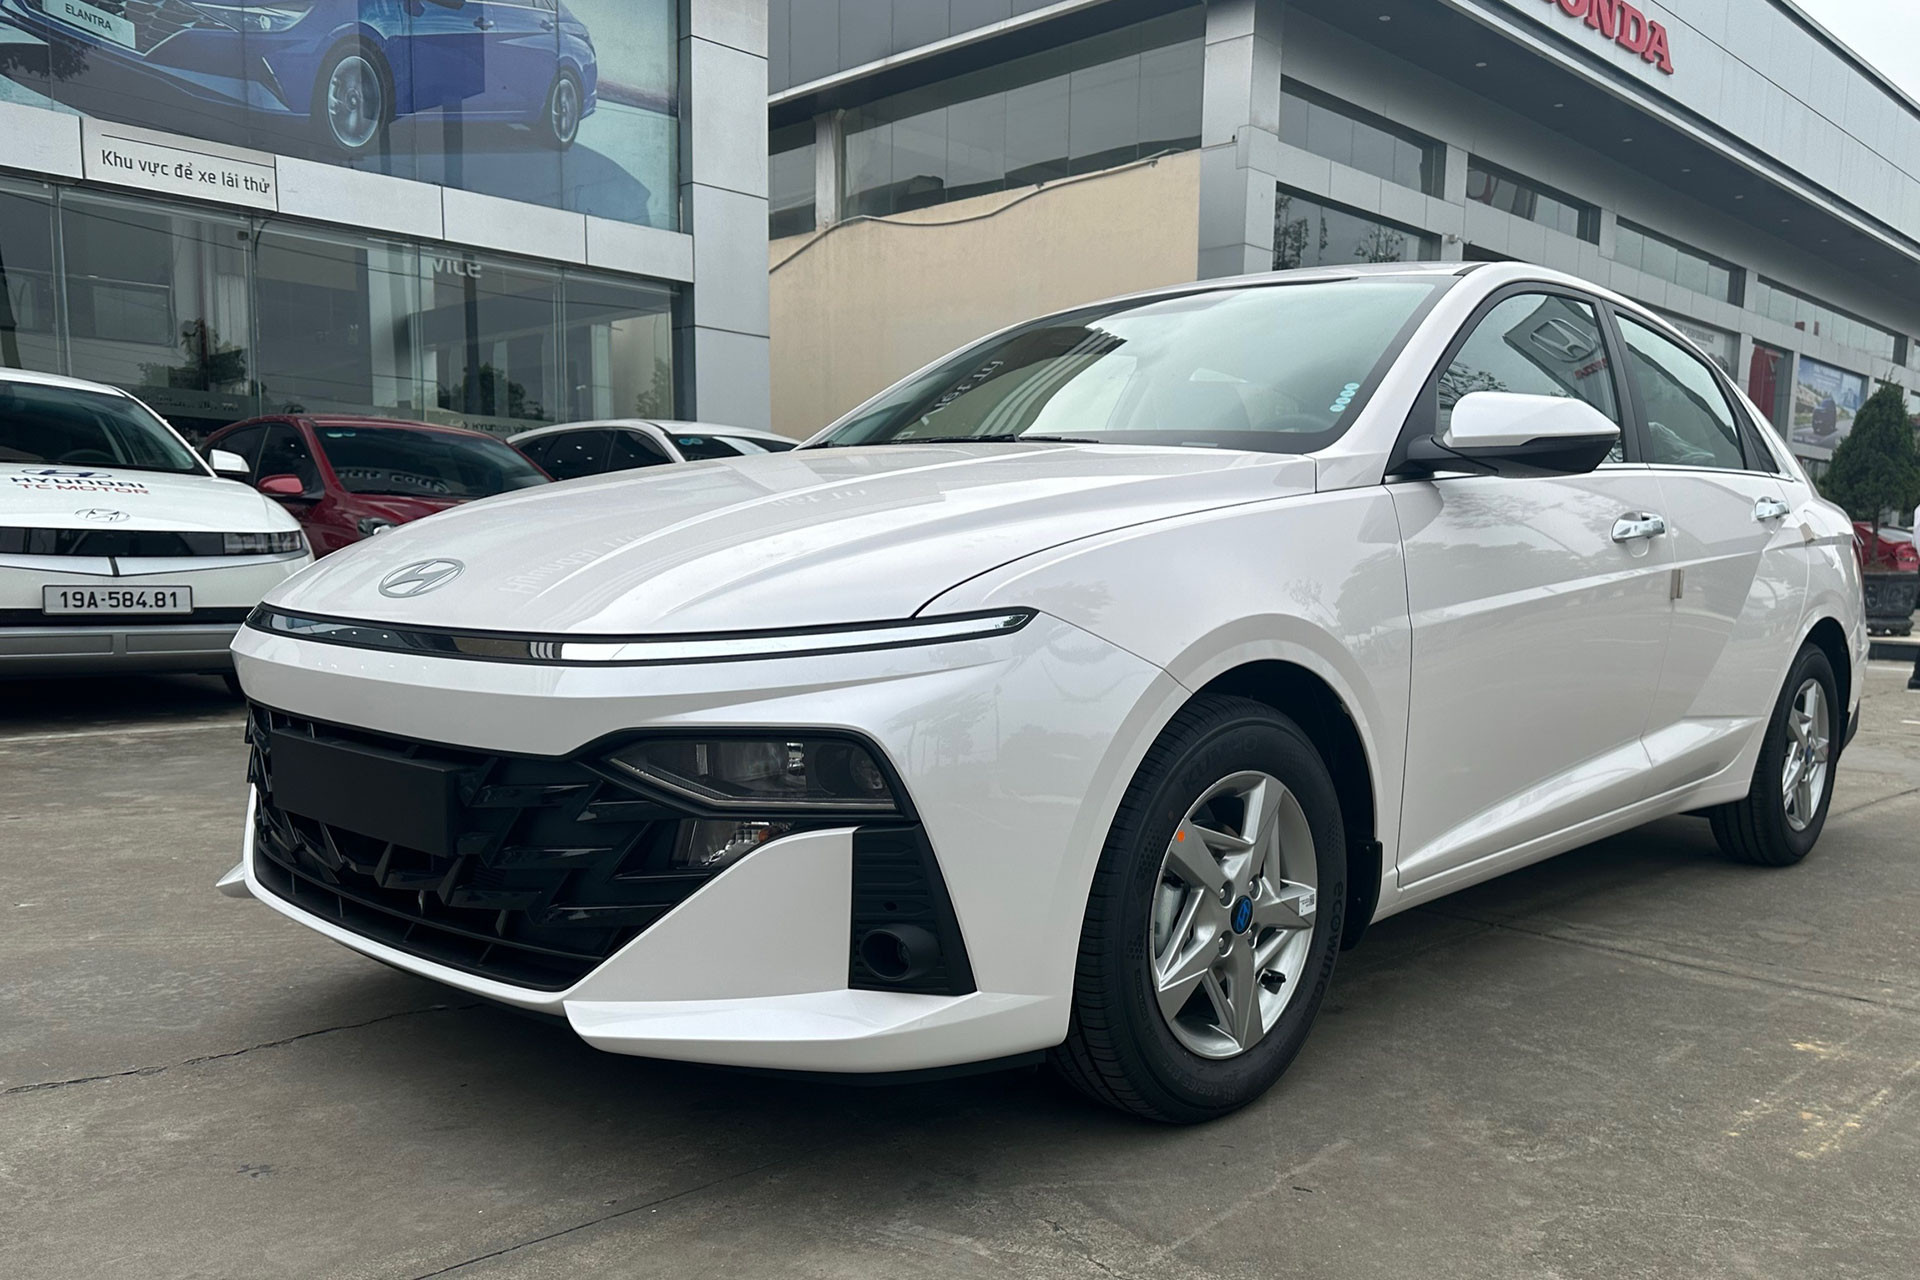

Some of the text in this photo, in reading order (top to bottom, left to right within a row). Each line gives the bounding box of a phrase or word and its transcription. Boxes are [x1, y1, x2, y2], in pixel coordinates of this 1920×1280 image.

[65, 3, 112, 31] ELANTRA
[1543, 0, 1674, 75] NDA
[101, 149, 270, 194] Khu vực để xe lái thử
[10, 477, 146, 489] HYUNDAI
[55, 485, 150, 495] MOTOR
[60, 591, 178, 609] 19A-584.81
